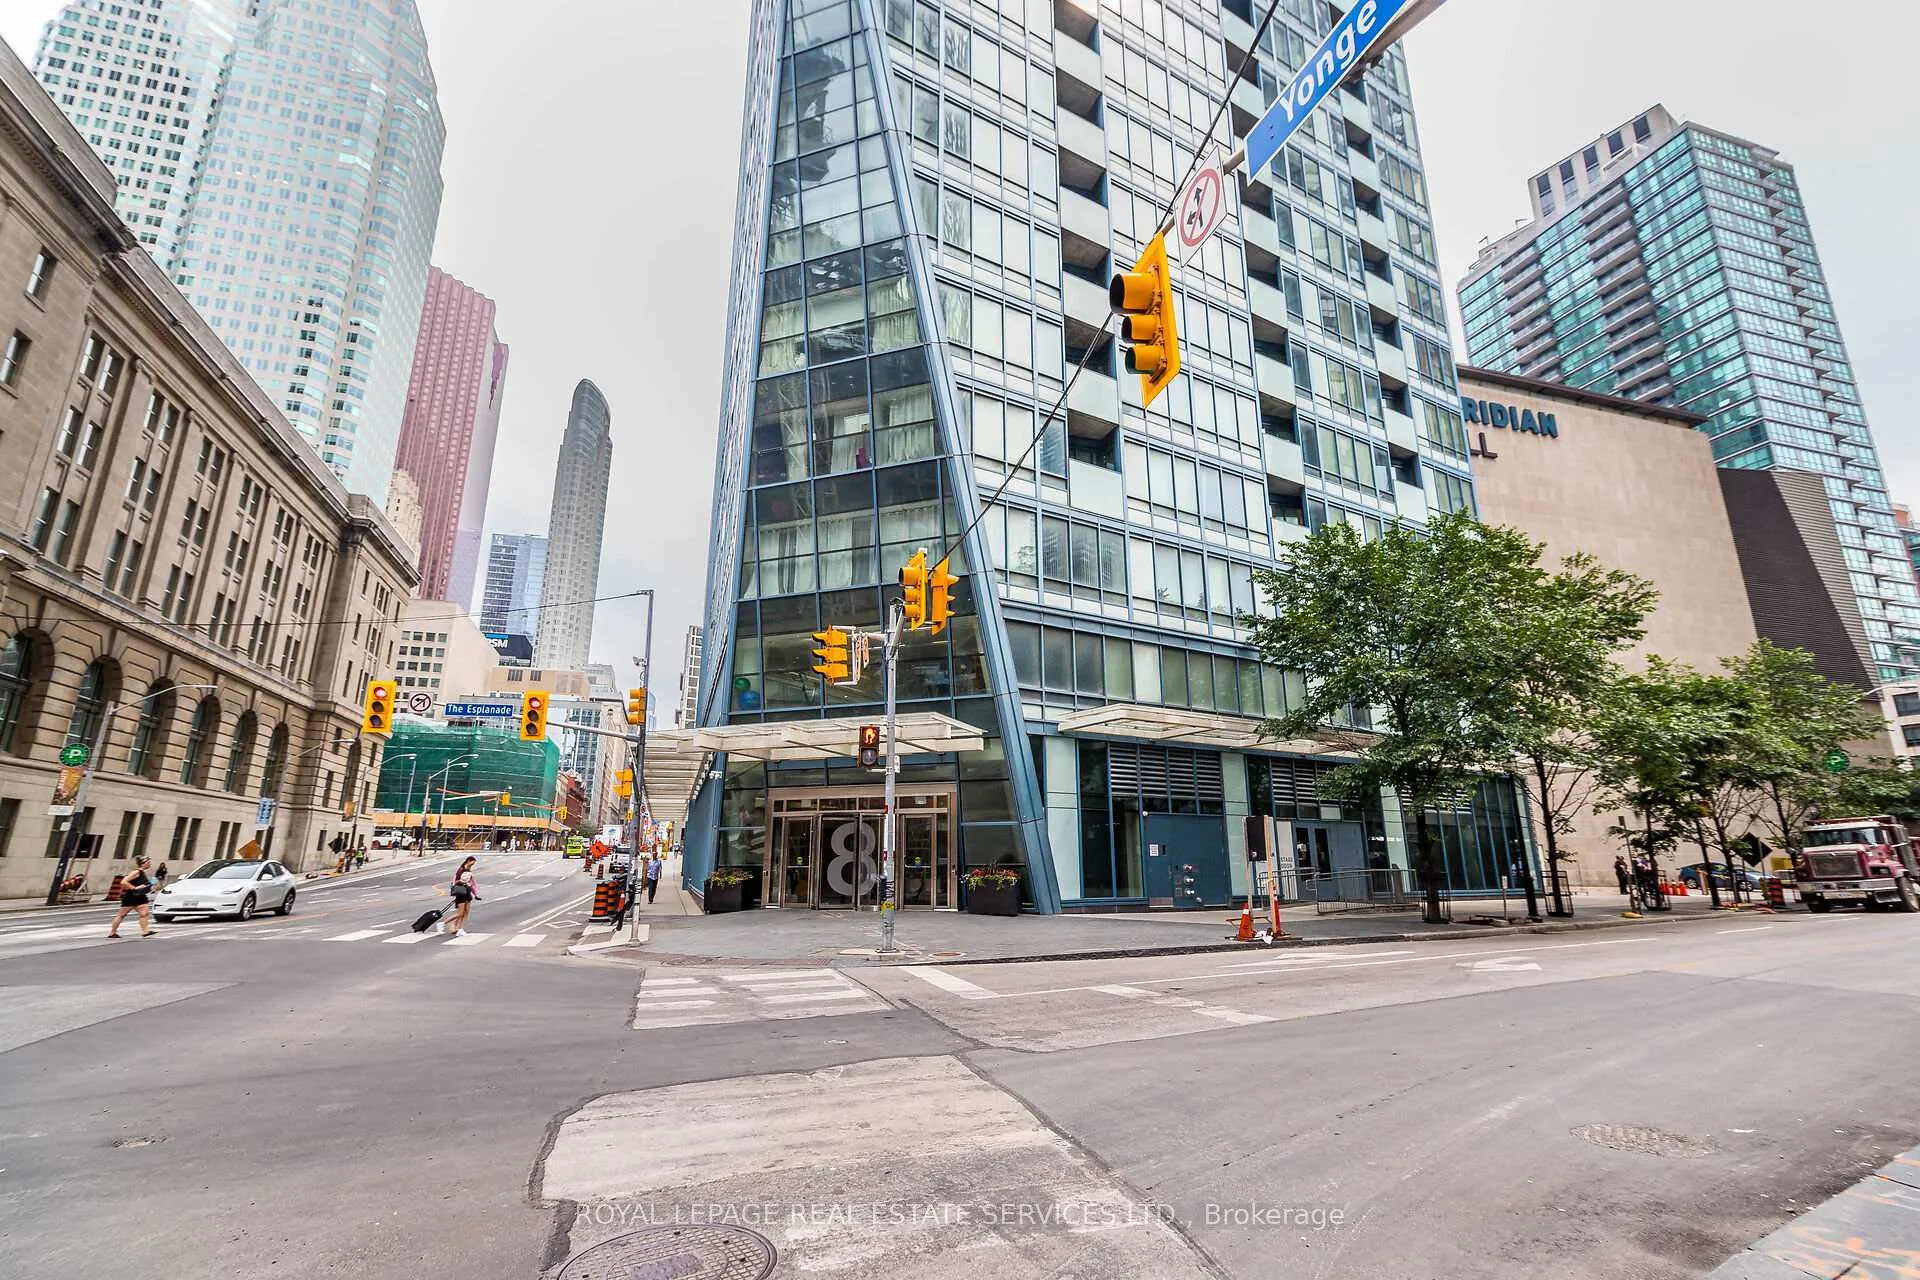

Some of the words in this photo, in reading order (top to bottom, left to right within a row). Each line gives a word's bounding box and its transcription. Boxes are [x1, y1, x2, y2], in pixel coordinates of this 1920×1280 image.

[1280, 0, 1377, 122] Yonge
[1461, 396, 1558, 438] RIDIAN
[448, 704, 463, 713] The
[467, 705, 511, 716] Esplanade
[827, 822, 877, 897] 8
